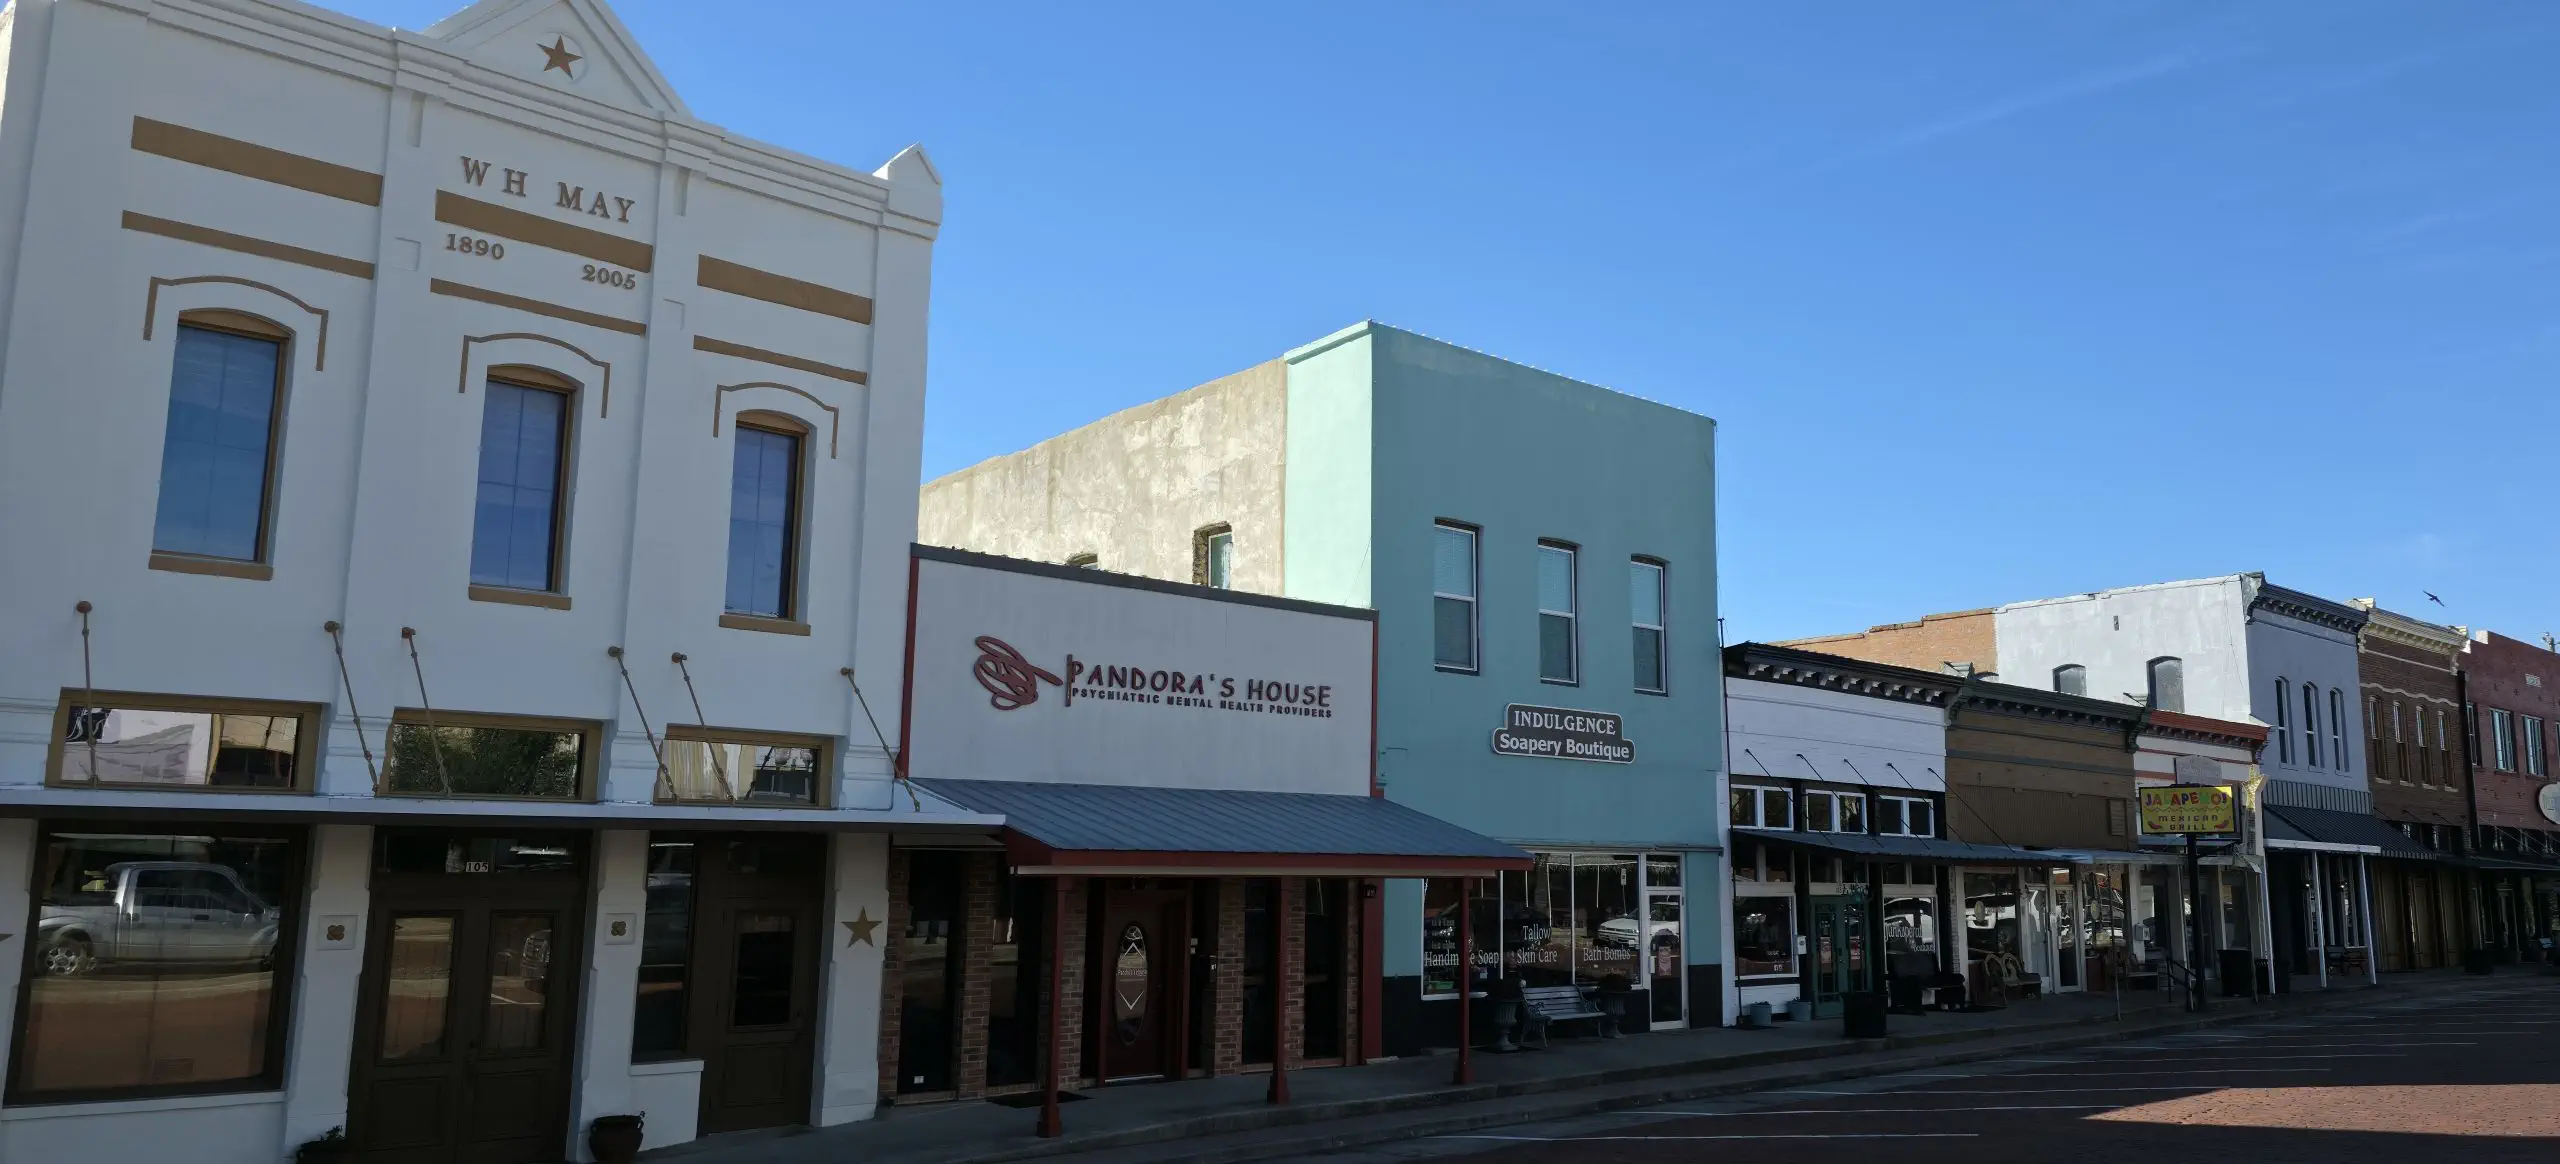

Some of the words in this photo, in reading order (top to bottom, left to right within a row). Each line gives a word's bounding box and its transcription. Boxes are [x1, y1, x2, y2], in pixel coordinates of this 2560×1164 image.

[556, 180, 636, 223] MAY
[445, 233, 505, 260] 1890
[582, 264, 637, 291] 2005
[1071, 660, 1235, 698] PANDORA'S
[1247, 678, 1332, 708] HOUSE
[1072, 687, 1160, 704] PSYCHIATRIC
[1167, 696, 1214, 708] MENTAL
[1220, 700, 1263, 713] HEALTH
[1269, 705, 1332, 718] PROVIDERS
[1514, 710, 1616, 736] INDULGENCE
[1500, 733, 1562, 756] Soapery
[1566, 738, 1630, 760] Boutique
[2158, 814, 2218, 822] MEXICAN
[2169, 823, 2207, 831] GRILL
[467, 862, 488, 871] 105
[1522, 924, 1553, 942] Tallow
[1424, 950, 1475, 966] Handme
[1478, 949, 1500, 966] Soap
[1516, 949, 1536, 964] Skin
[1538, 949, 1558, 963] Care
[1583, 947, 1602, 962] Bath
[1604, 945, 1631, 961] Bombs
